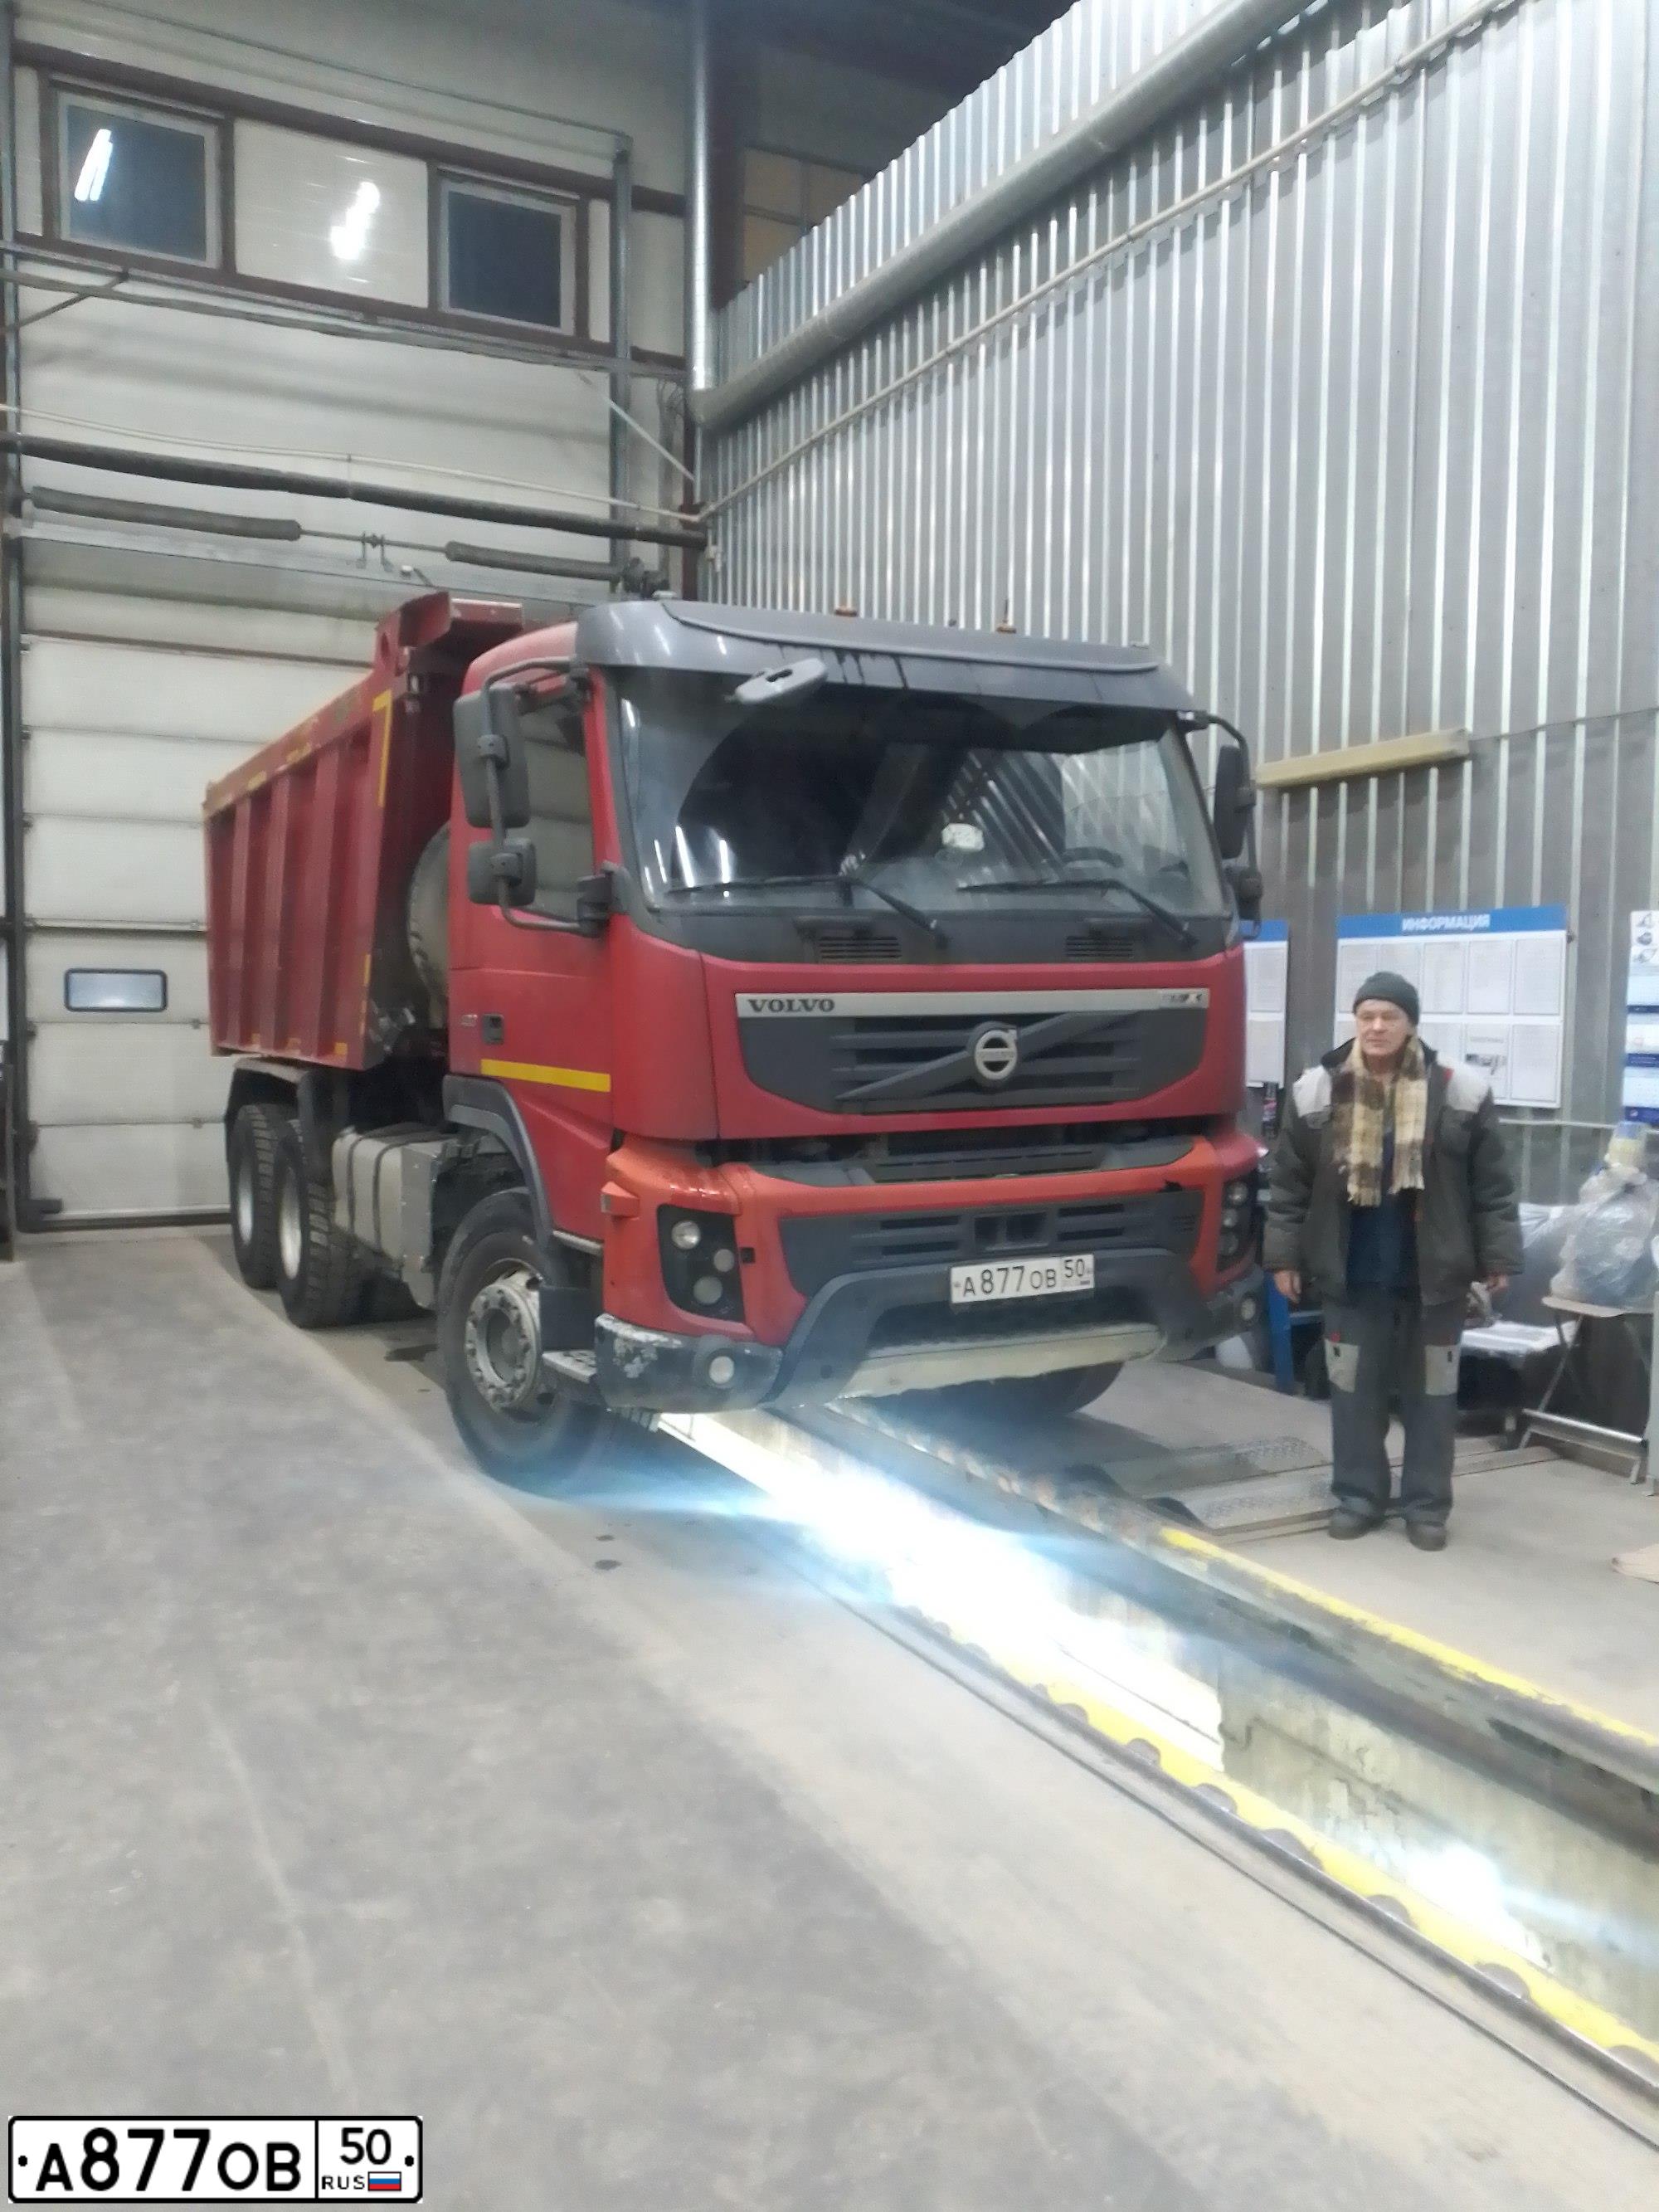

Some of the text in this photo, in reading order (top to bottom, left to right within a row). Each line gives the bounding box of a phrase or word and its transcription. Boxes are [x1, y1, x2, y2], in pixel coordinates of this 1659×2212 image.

[1402, 914, 1491, 931] ИНФОРМАЦИЯ
[748, 998, 835, 1013] VOLVO
[1064, 1259, 1085, 1278] 50
